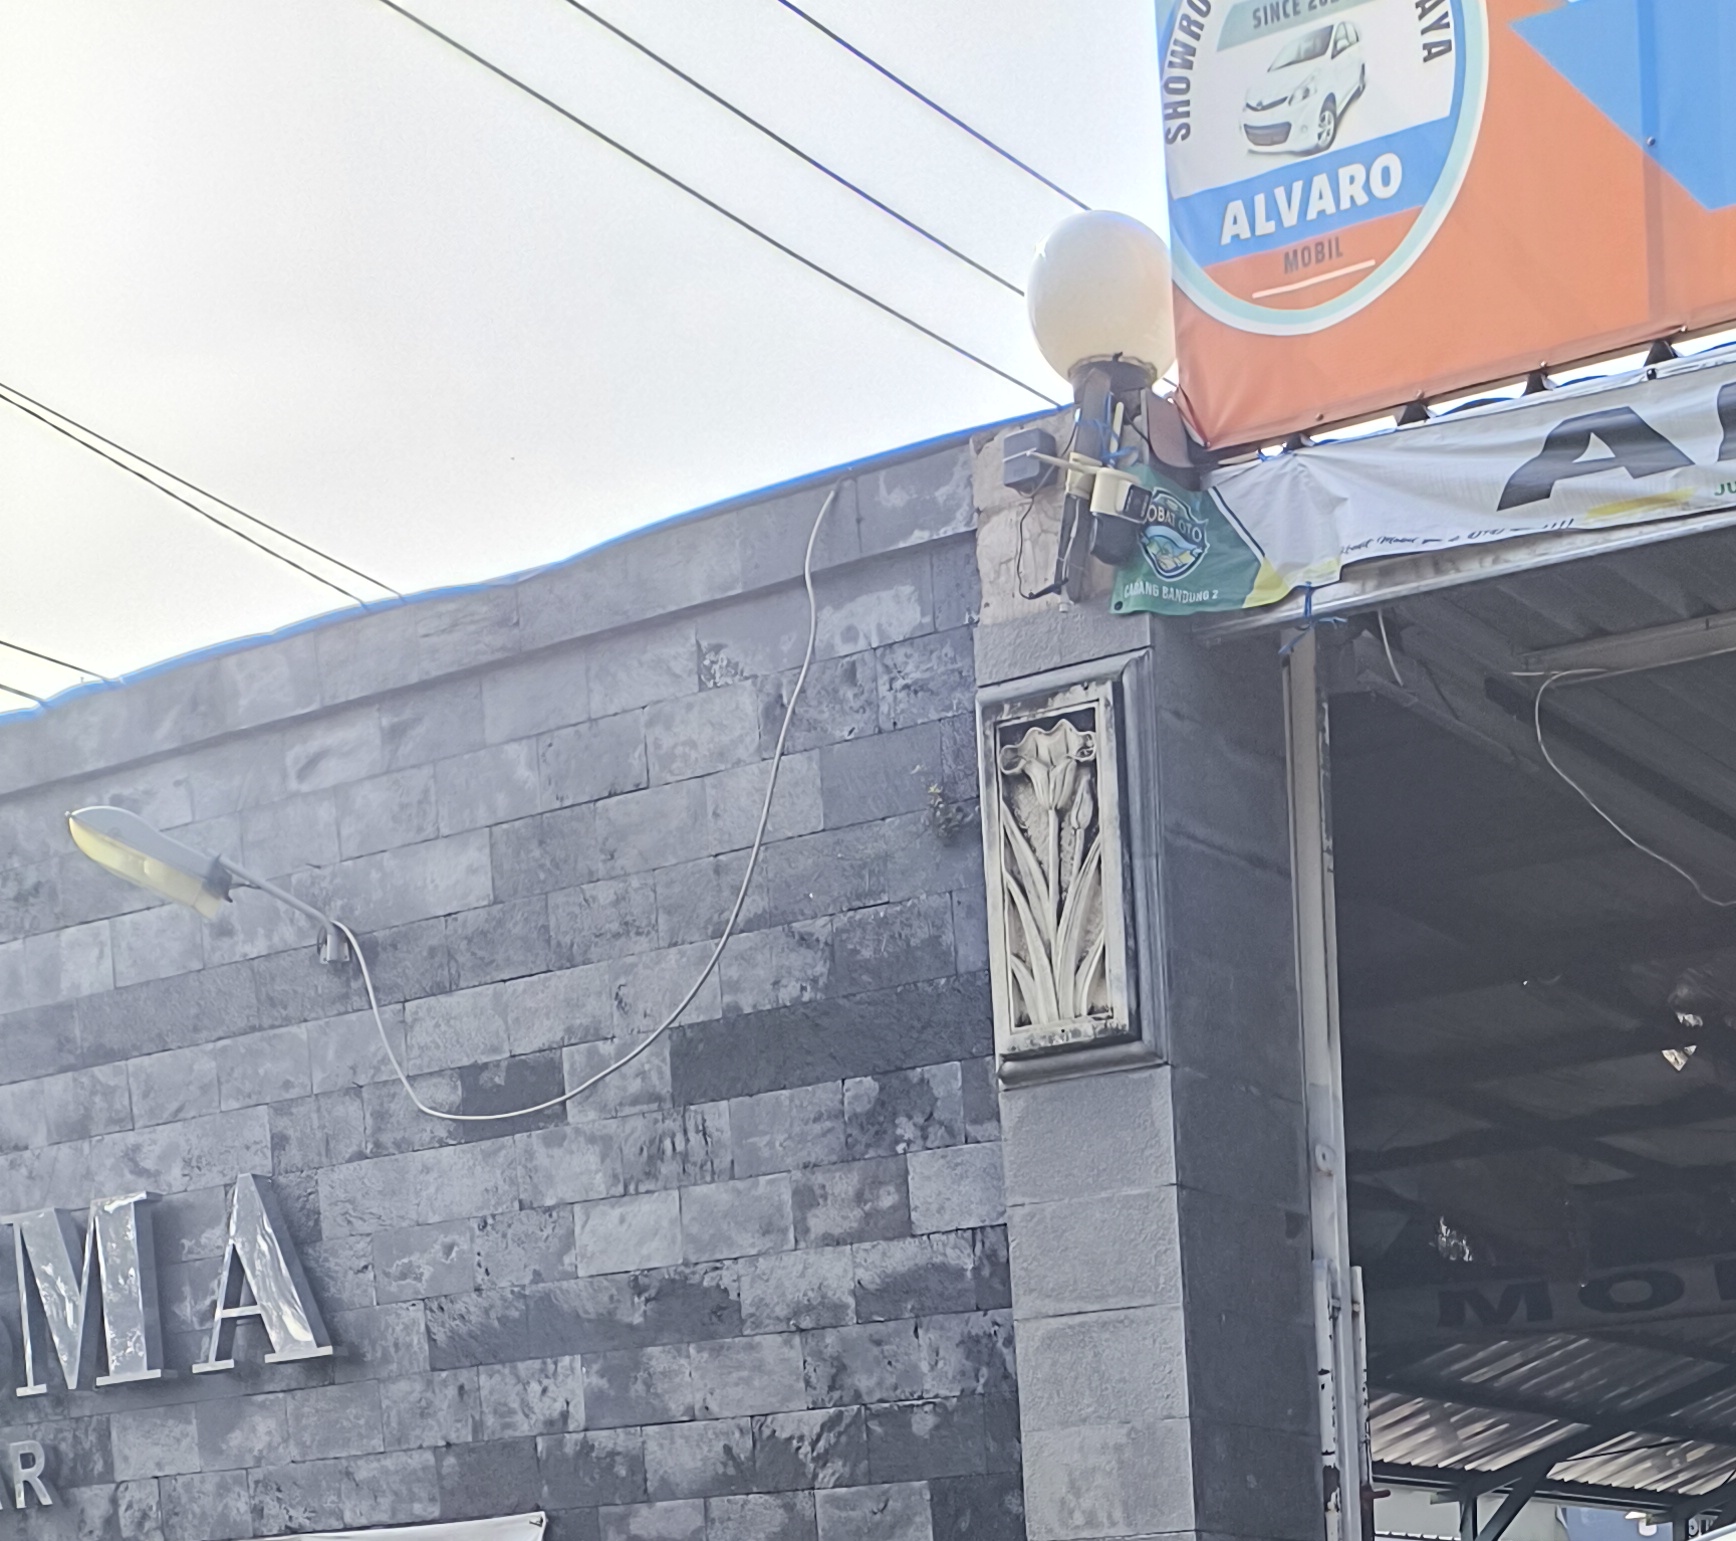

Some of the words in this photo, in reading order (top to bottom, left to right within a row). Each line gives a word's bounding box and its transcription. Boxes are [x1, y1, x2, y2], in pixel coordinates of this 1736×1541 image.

[1220, 152, 1403, 246] ALVARO
[1283, 236, 1344, 275] MOBIL
[1147, 504, 1176, 528] OBAT
[1211, 588, 1219, 600] 2
[2, 1440, 54, 1509] R
